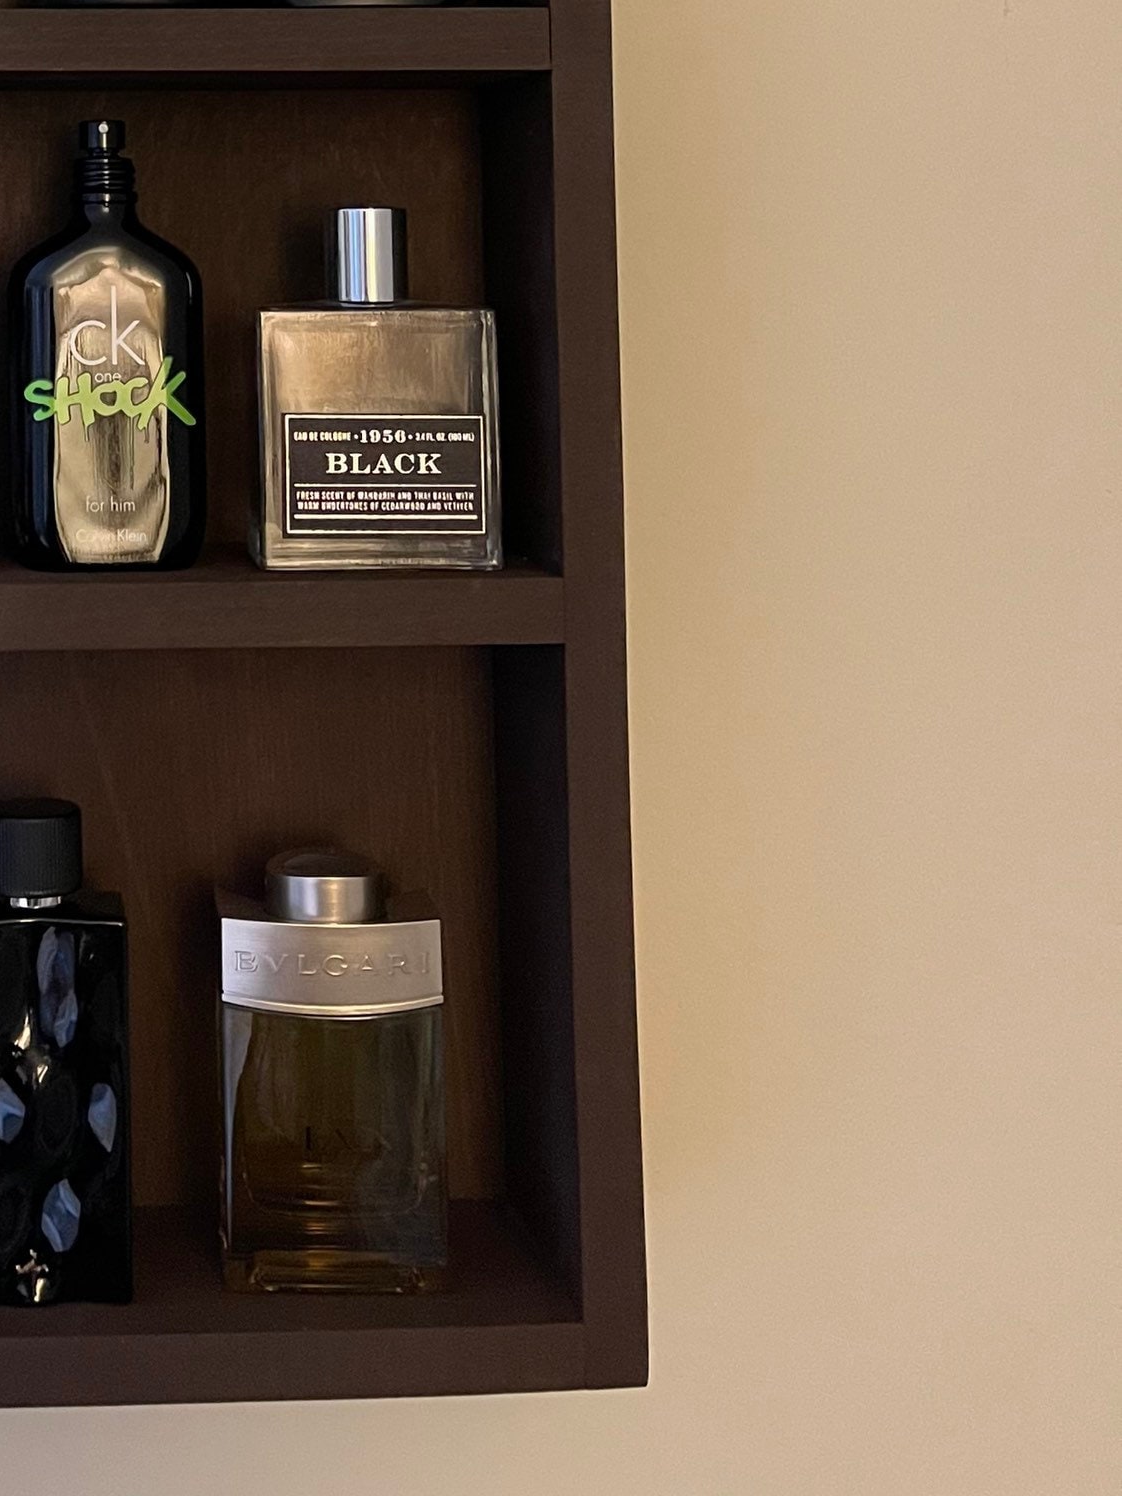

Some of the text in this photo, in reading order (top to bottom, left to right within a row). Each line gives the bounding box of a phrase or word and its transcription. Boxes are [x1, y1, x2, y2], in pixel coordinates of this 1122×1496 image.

[69, 285, 145, 366] ck
[94, 372, 122, 383] one
[293, 431, 308, 441] EAU
[319, 431, 351, 442] COLOGNE
[360, 429, 406, 444] 1956
[325, 453, 442, 474] BLACK
[296, 491, 320, 501] FRESH
[321, 491, 344, 501] SCENT
[346, 491, 355, 501] OF
[397, 491, 412, 501] AND
[432, 491, 453, 501] BASIL
[455, 491, 474, 501] WITH
[86, 495, 136, 513] for him
[297, 501, 319, 510] WARM
[321, 501, 368, 511] UNDERTONES
[369, 501, 379, 511] OF
[381, 501, 425, 511] CEDARWOOD
[426, 501, 442, 511] AND
[117, 528, 147, 542] Klein
[234, 950, 429, 976] BVLGARI
